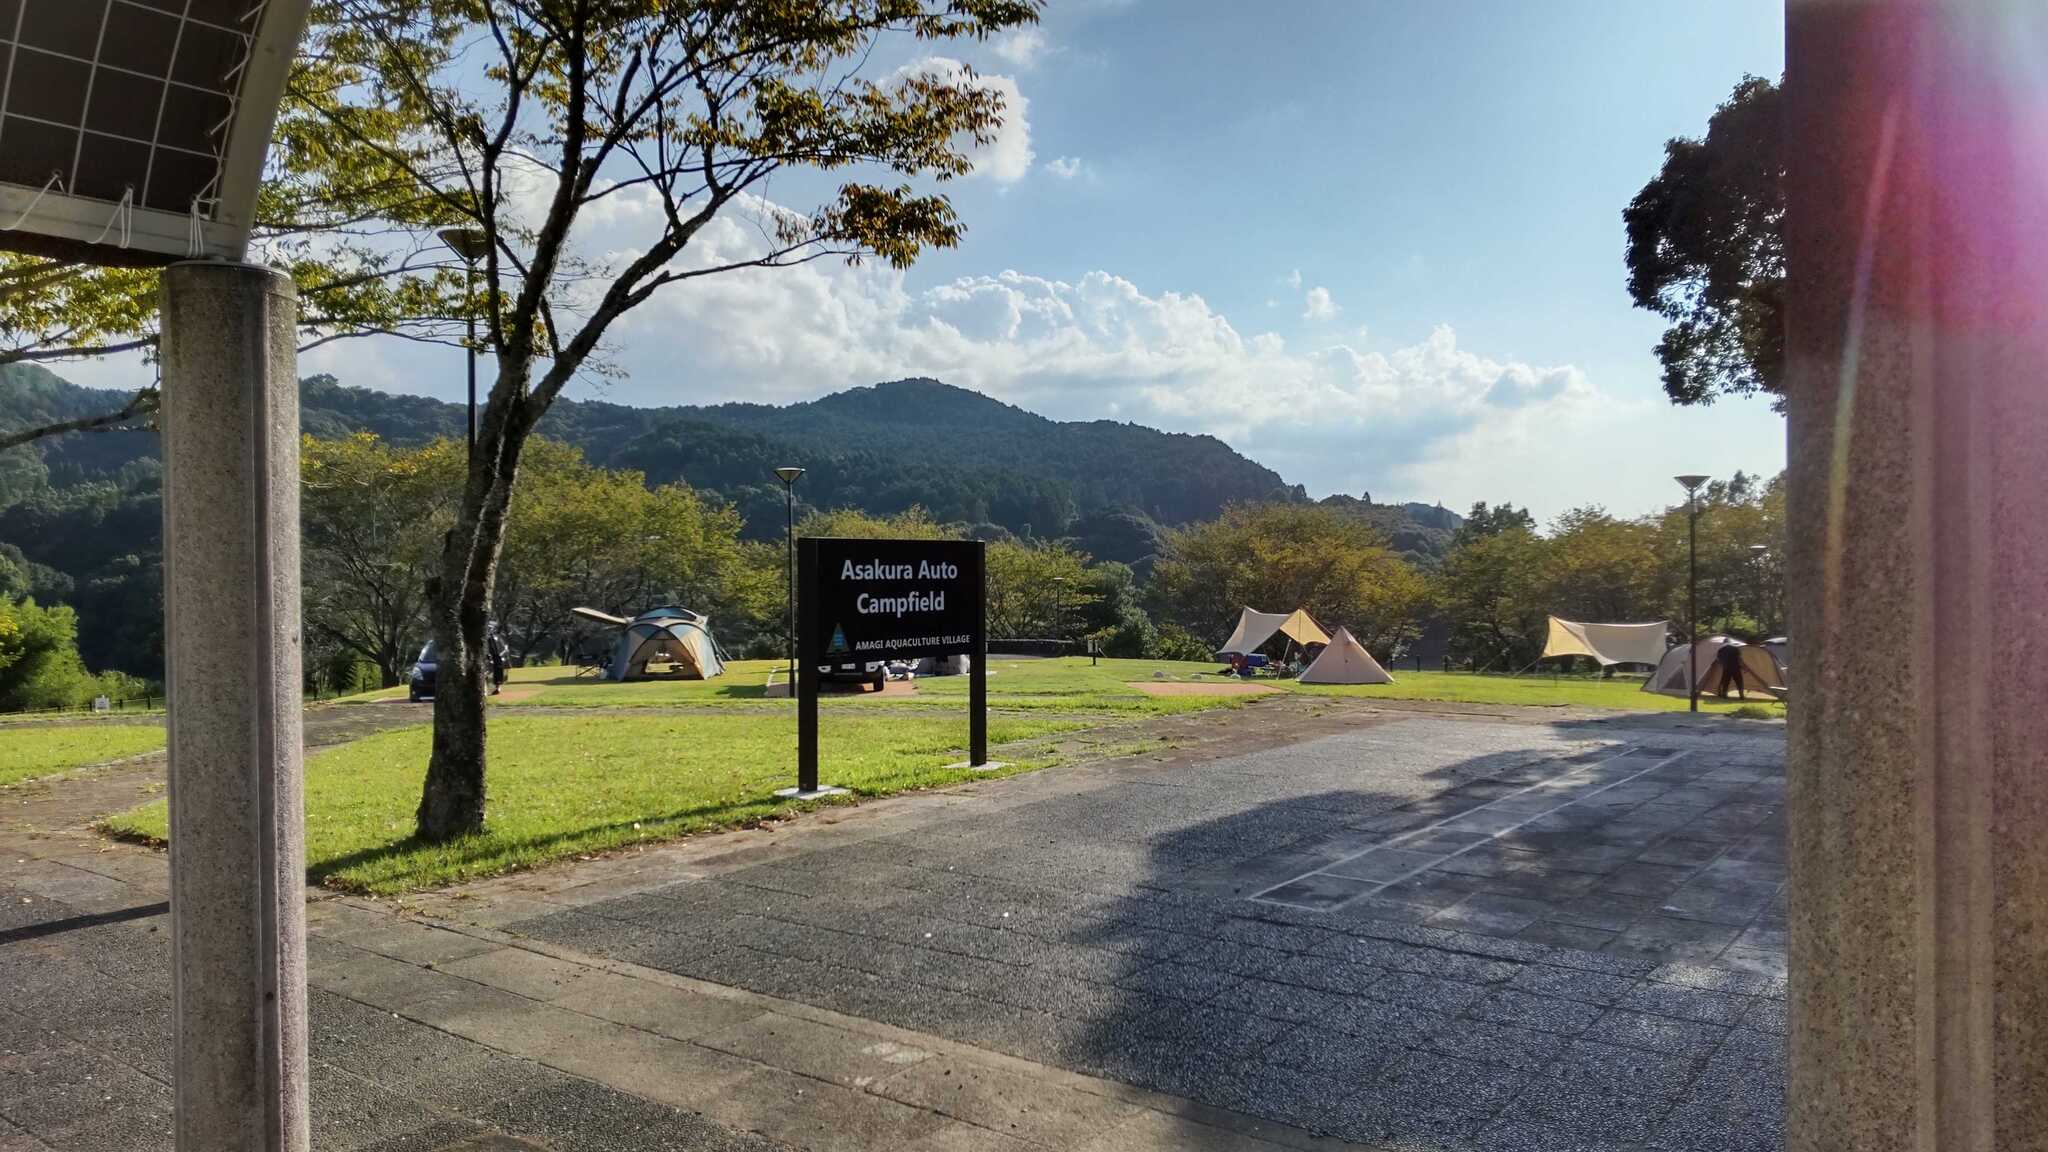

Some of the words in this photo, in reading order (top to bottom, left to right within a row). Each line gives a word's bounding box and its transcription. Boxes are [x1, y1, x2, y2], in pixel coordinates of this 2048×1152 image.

[841, 558, 913, 580] Asakura
[918, 560, 958, 579] Auto
[857, 591, 945, 618] Campfield
[856, 641, 884, 650] AMAGI
[885, 636, 941, 649] AQUACULTURE
[941, 634, 971, 645] VILLAGE
